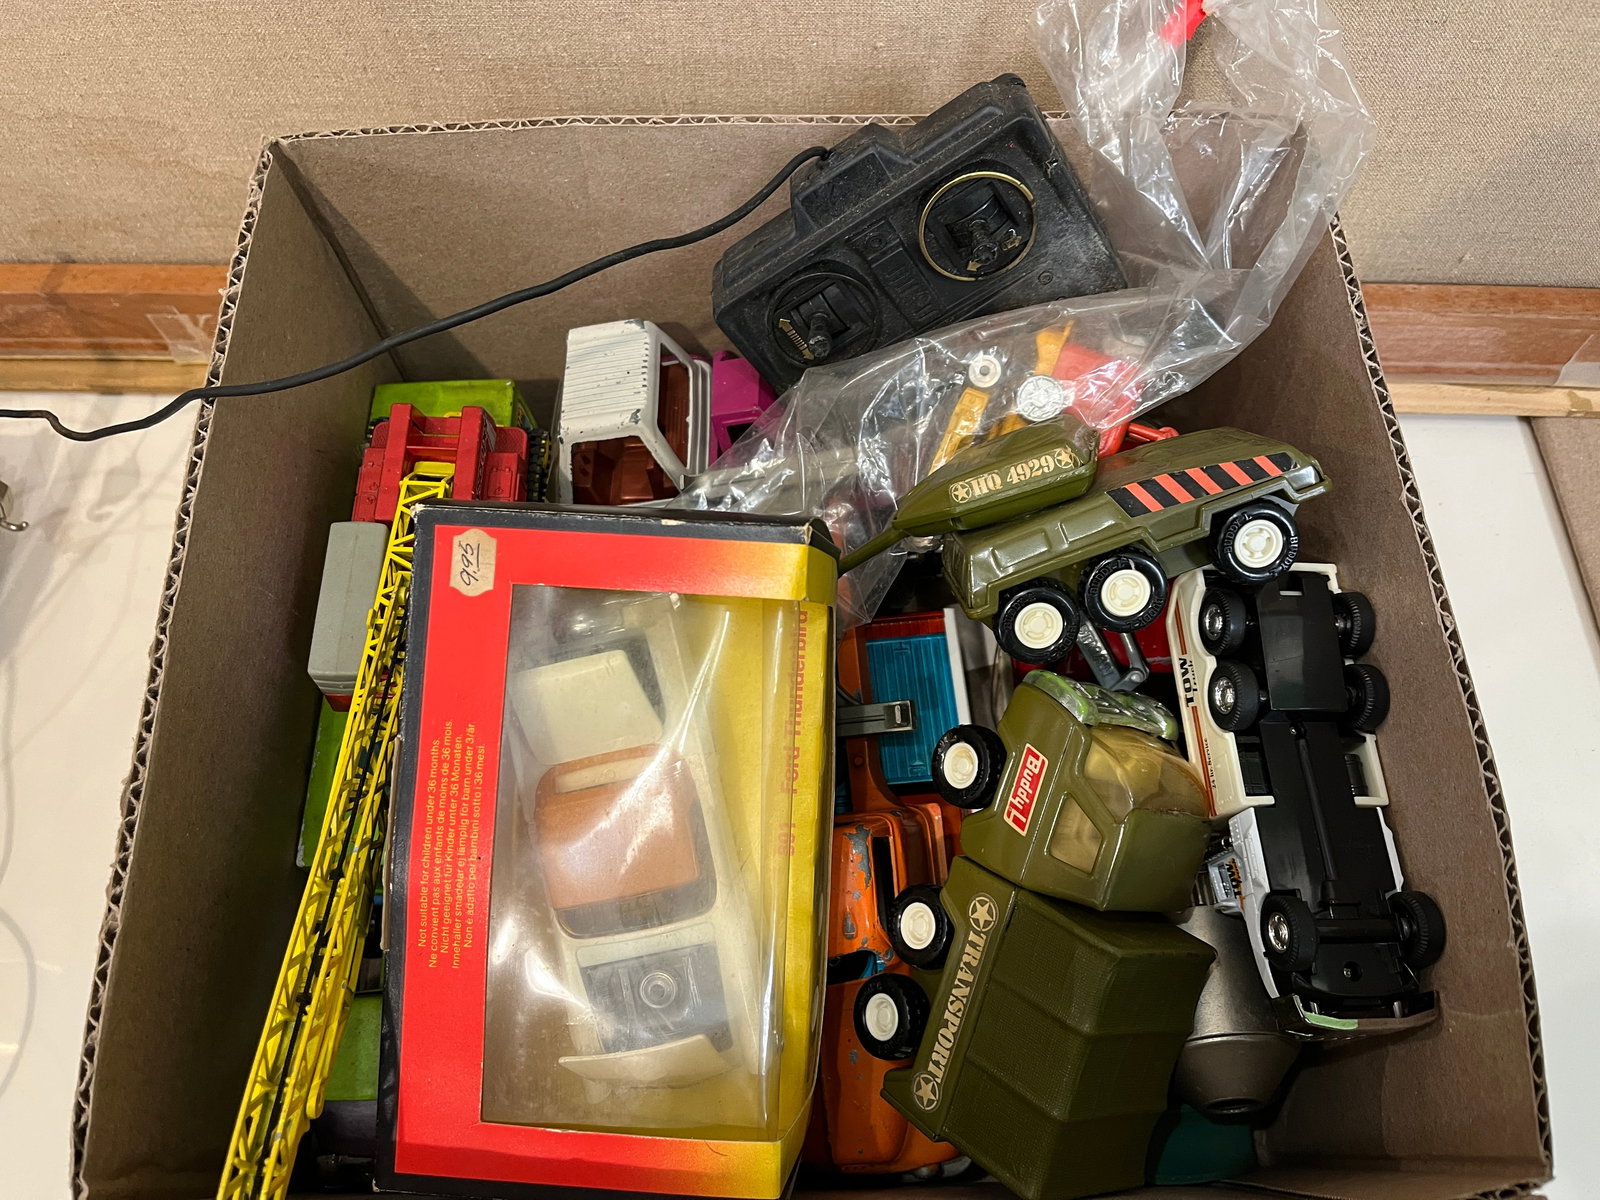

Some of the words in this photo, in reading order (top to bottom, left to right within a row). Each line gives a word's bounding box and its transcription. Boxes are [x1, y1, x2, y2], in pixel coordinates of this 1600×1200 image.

[970, 473, 1003, 497] HQ
[1006, 454, 1055, 484] 4929
[1178, 657, 1194, 708] TOW
[442, 747, 451, 760] 36
[463, 746, 473, 775] under
[441, 763, 449, 775] de
[474, 772, 483, 784] 36
[778, 747, 800, 794] Ford
[428, 780, 436, 793] 36
[439, 778, 448, 808] moins
[450, 784, 459, 796] 36
[461, 778, 471, 800] barn
[425, 795, 435, 825] under
[437, 811, 445, 823] de
[447, 799, 457, 825] unter
[472, 792, 481, 817] sotto
[422, 827, 432, 868] children
[433, 826, 444, 863] enfants
[445, 828, 454, 861] Kinder
[469, 820, 479, 861] bambini
[420, 870, 429, 884] for
[433, 867, 441, 884] aux
[468, 864, 477, 880] per
[420, 887, 428, 926] suitable
[432, 887, 441, 905] pas
[442, 880, 452, 924] geeignet
[418, 929, 426, 947] Not
[431, 908, 439, 951] convient
[440, 927, 449, 953] Nicht
[464, 926, 473, 947] Non
[429, 954, 437, 967] Ne
[927, 930, 987, 1084] TRANSPORT
